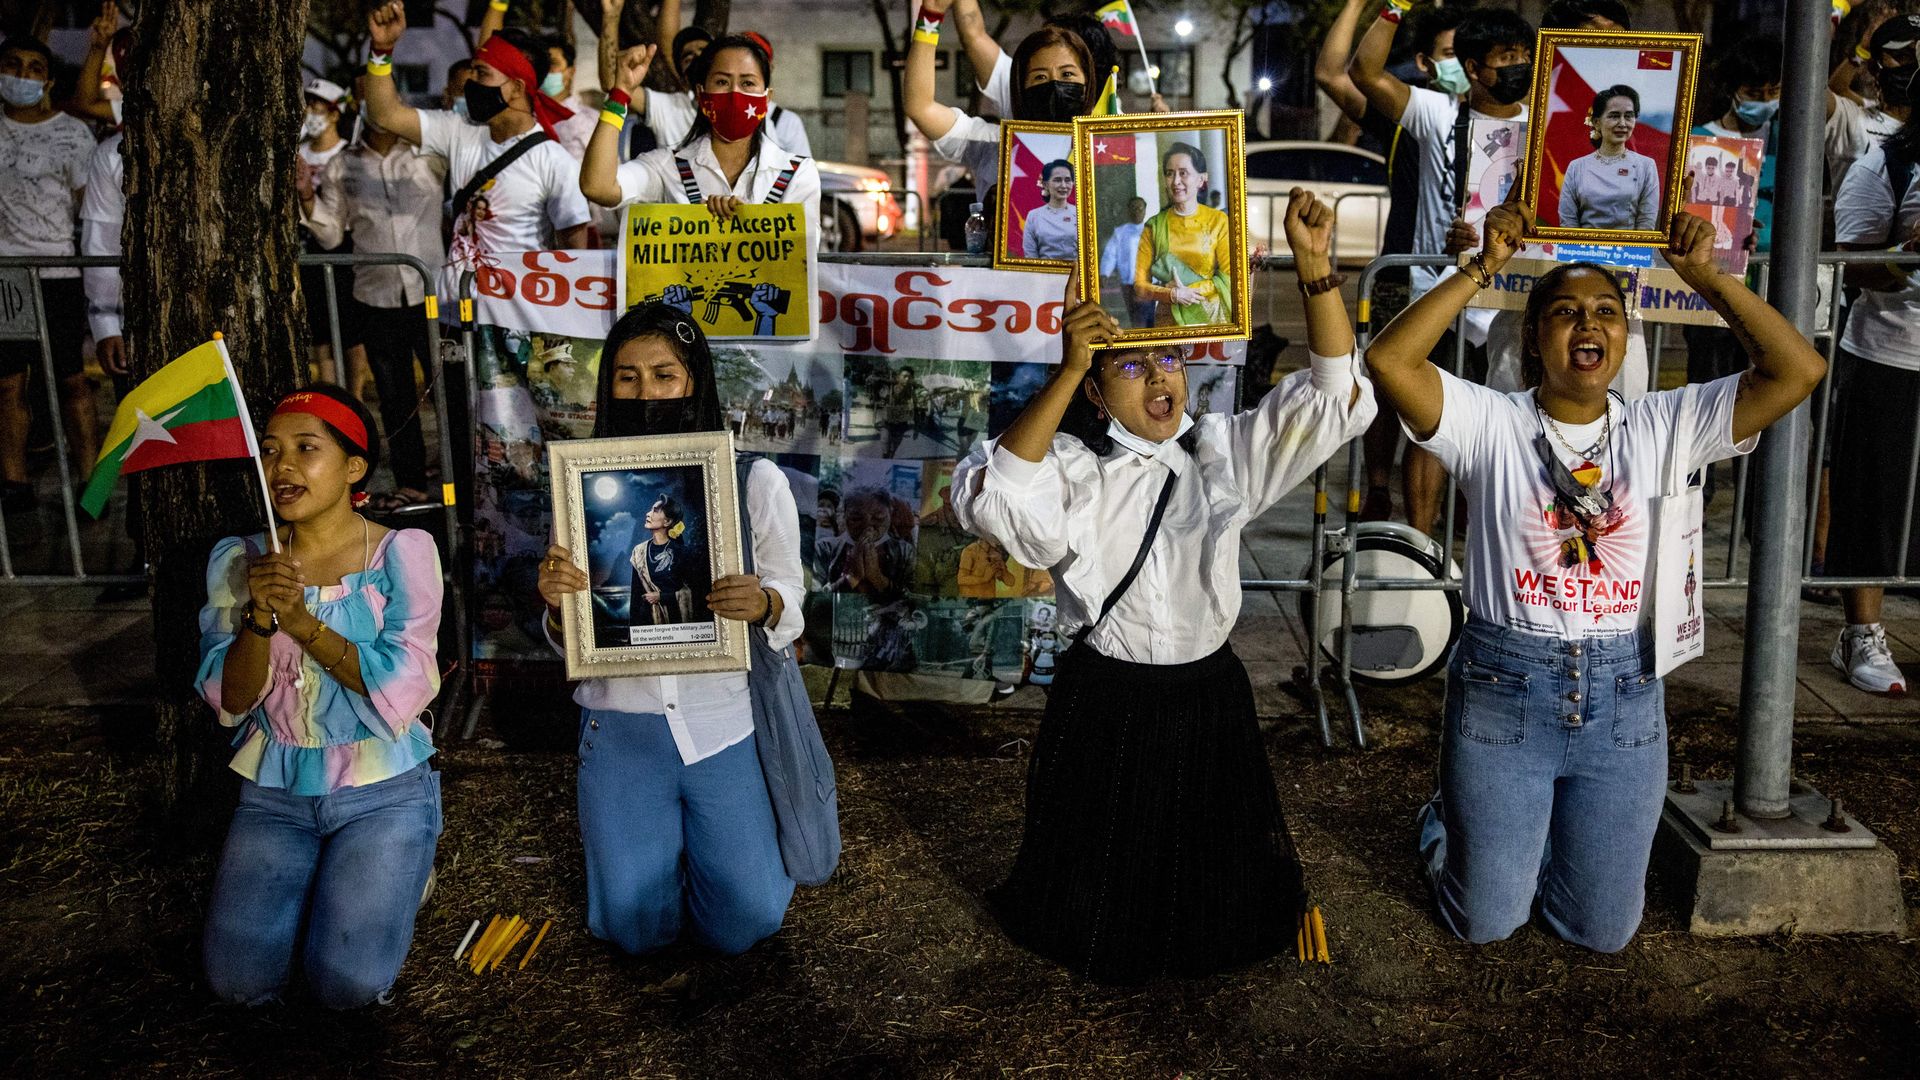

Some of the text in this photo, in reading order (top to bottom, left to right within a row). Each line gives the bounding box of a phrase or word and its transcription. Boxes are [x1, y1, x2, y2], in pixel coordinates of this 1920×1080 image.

[633, 213, 797, 238] We Dont Accept
[633, 240, 794, 264] MILITARY COUP
[1557, 246, 1612, 259] Responsibility
[1613, 251, 1622, 259] to
[1623, 251, 1651, 261] Protect
[1494, 273, 1541, 293] NEE
[1514, 567, 1641, 601] WE STAND
[1513, 591, 1638, 614] with our Leaders
